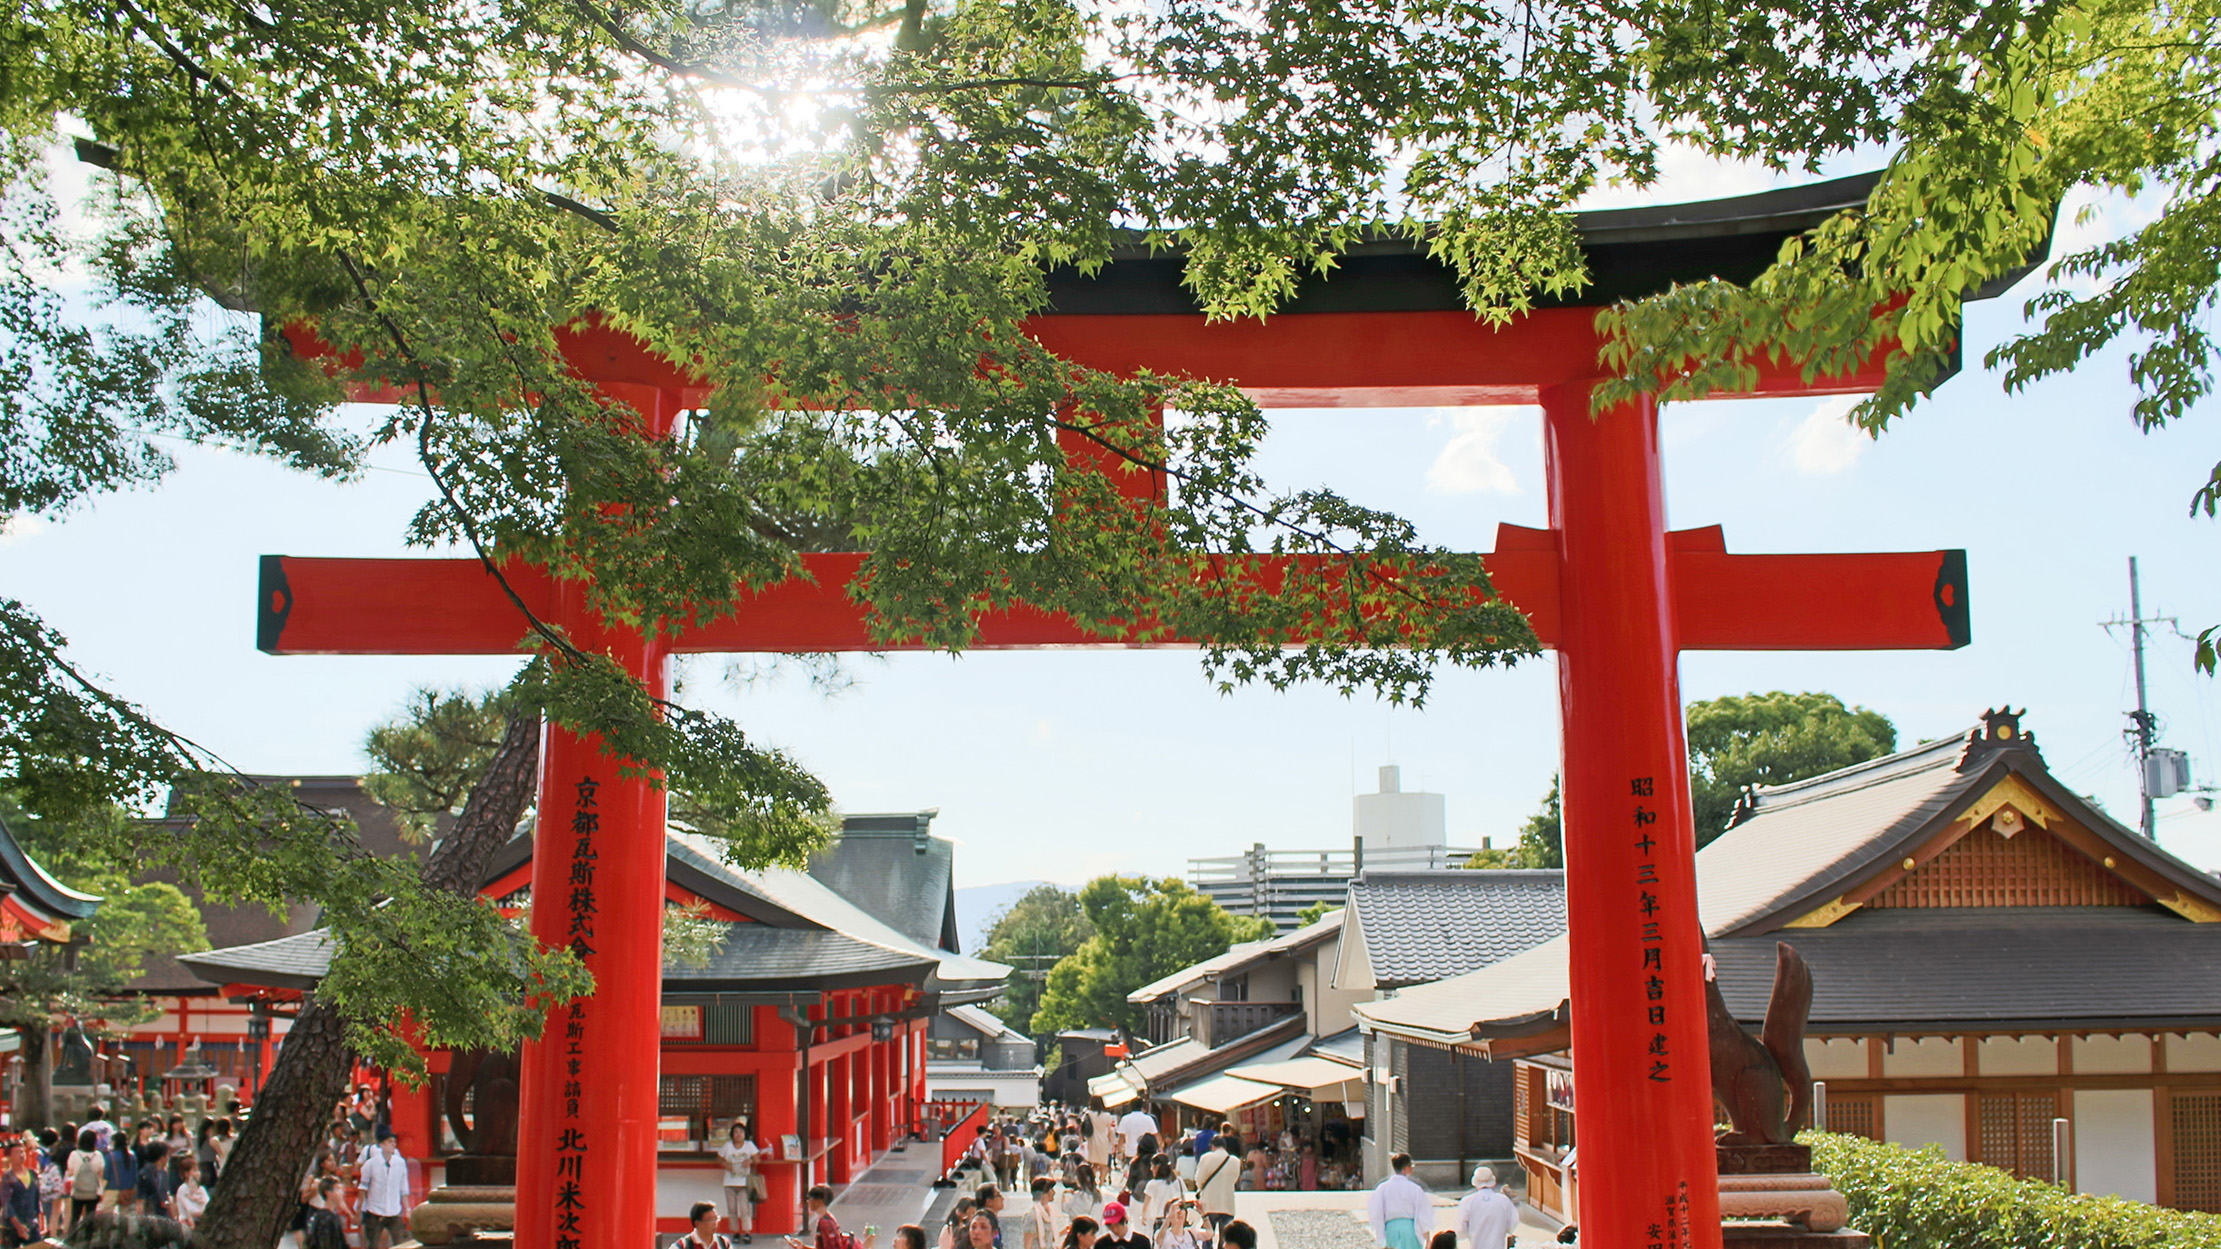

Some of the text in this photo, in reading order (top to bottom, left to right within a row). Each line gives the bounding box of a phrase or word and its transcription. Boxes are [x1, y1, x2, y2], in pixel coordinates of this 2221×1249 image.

[567, 775, 601, 997] 京都瓦斯株式會
[1631, 776, 1671, 1083] 昭和十三年三月吉日建之
